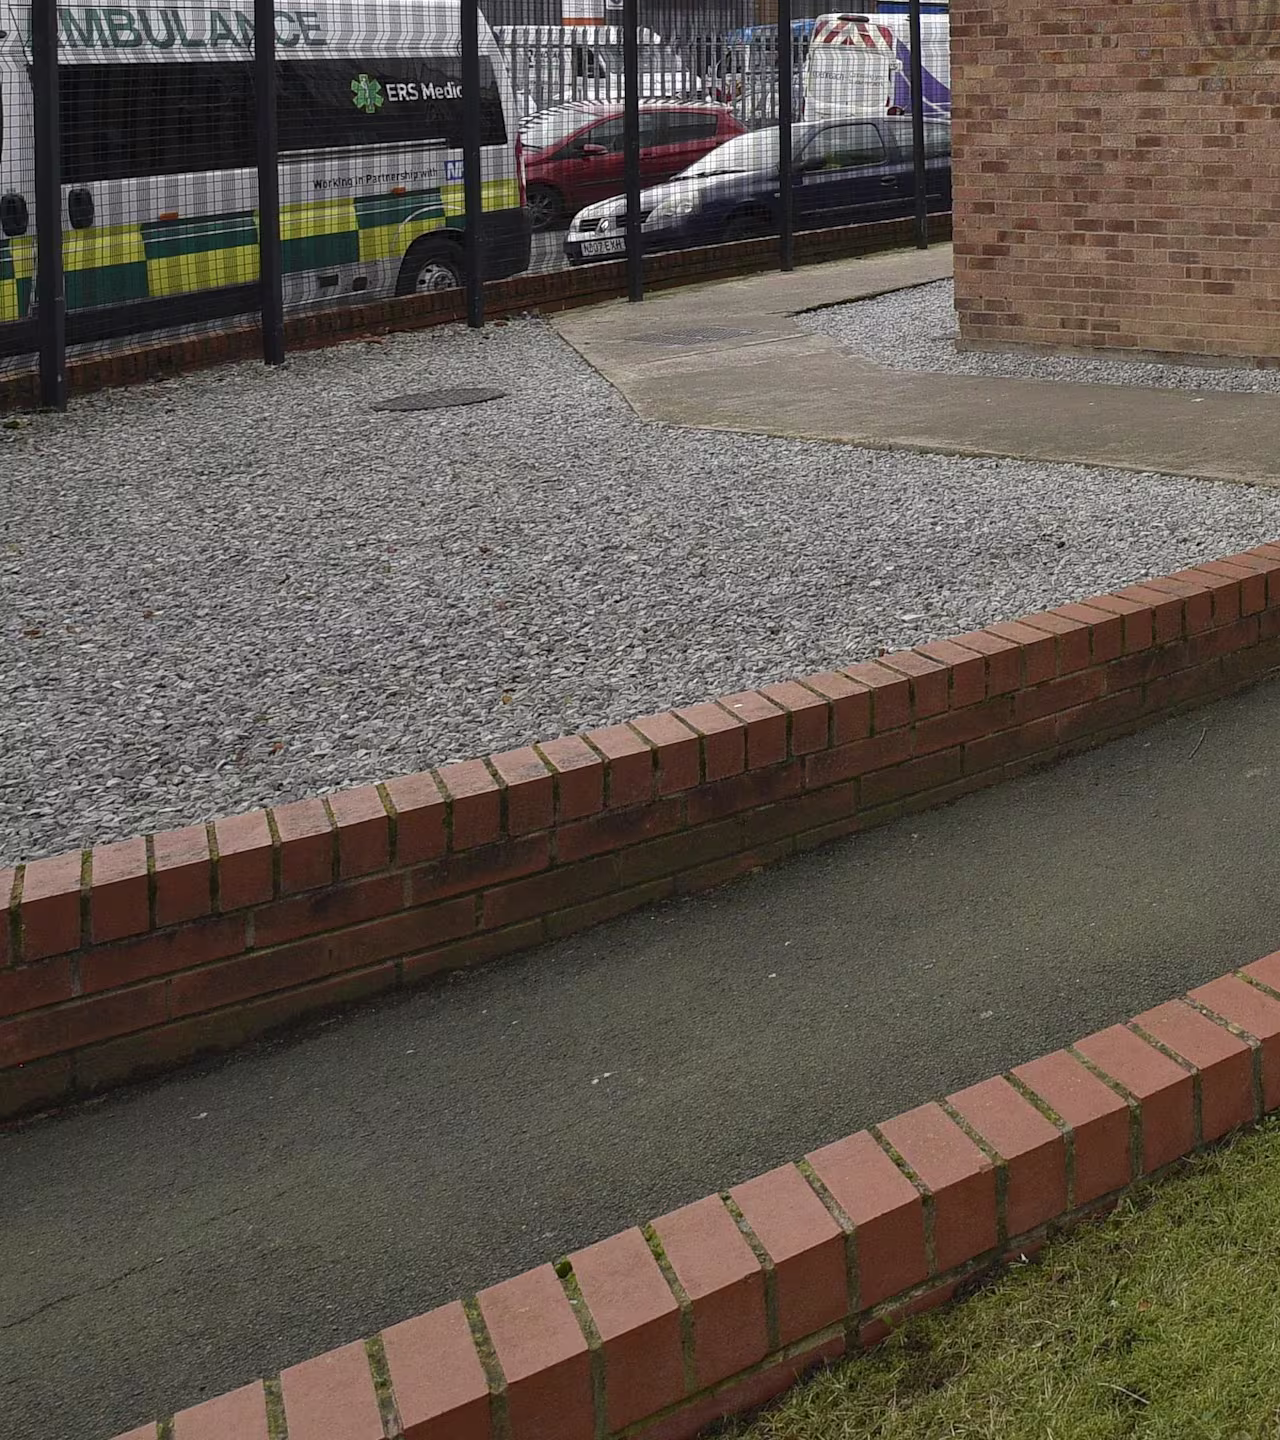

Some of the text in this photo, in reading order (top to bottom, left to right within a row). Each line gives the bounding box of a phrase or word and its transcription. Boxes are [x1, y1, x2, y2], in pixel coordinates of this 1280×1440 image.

[386, 82, 418, 102] ERS
[313, 178, 353, 190] Working
[355, 175, 364, 184] in
[366, 169, 418, 184] Partnership
[419, 168, 437, 177] with
